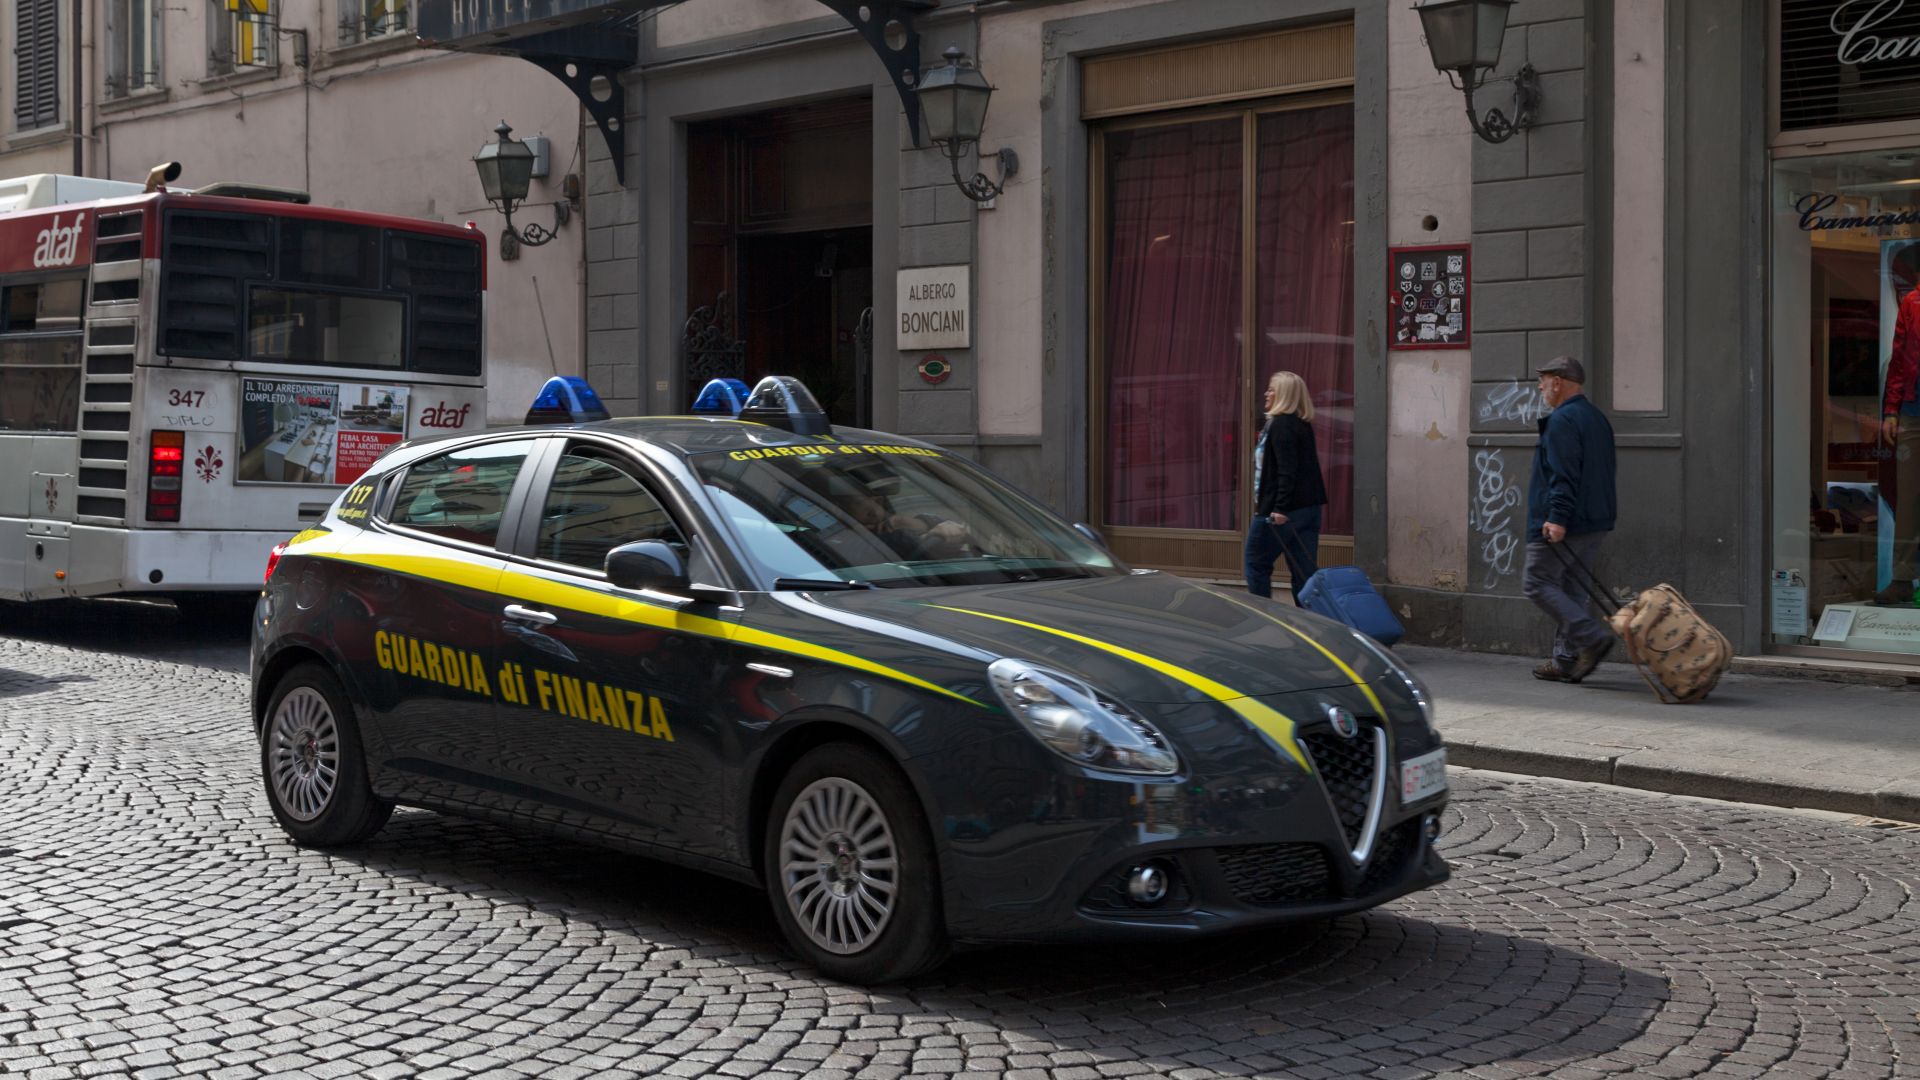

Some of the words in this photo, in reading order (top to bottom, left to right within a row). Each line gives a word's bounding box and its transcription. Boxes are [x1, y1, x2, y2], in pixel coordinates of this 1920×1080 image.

[33, 212, 85, 268] ataf
[909, 283, 956, 301] ALBERGO
[901, 309, 964, 334] BONCIANI
[246, 382, 254, 391] IL
[257, 382, 274, 392] TUO
[168, 389, 205, 408] 347
[245, 392, 286, 404] COMPLETO
[288, 394, 296, 404] A
[420, 401, 471, 429] ataf
[340, 434, 360, 442] FEBAL
[729, 445, 836, 462] GUARDIA
[838, 444, 862, 454] di
[862, 445, 943, 458] FINANZA
[347, 485, 374, 504] 117
[374, 629, 492, 696] GUARDIA
[498, 661, 530, 705] di
[533, 668, 675, 742] FINANZA
